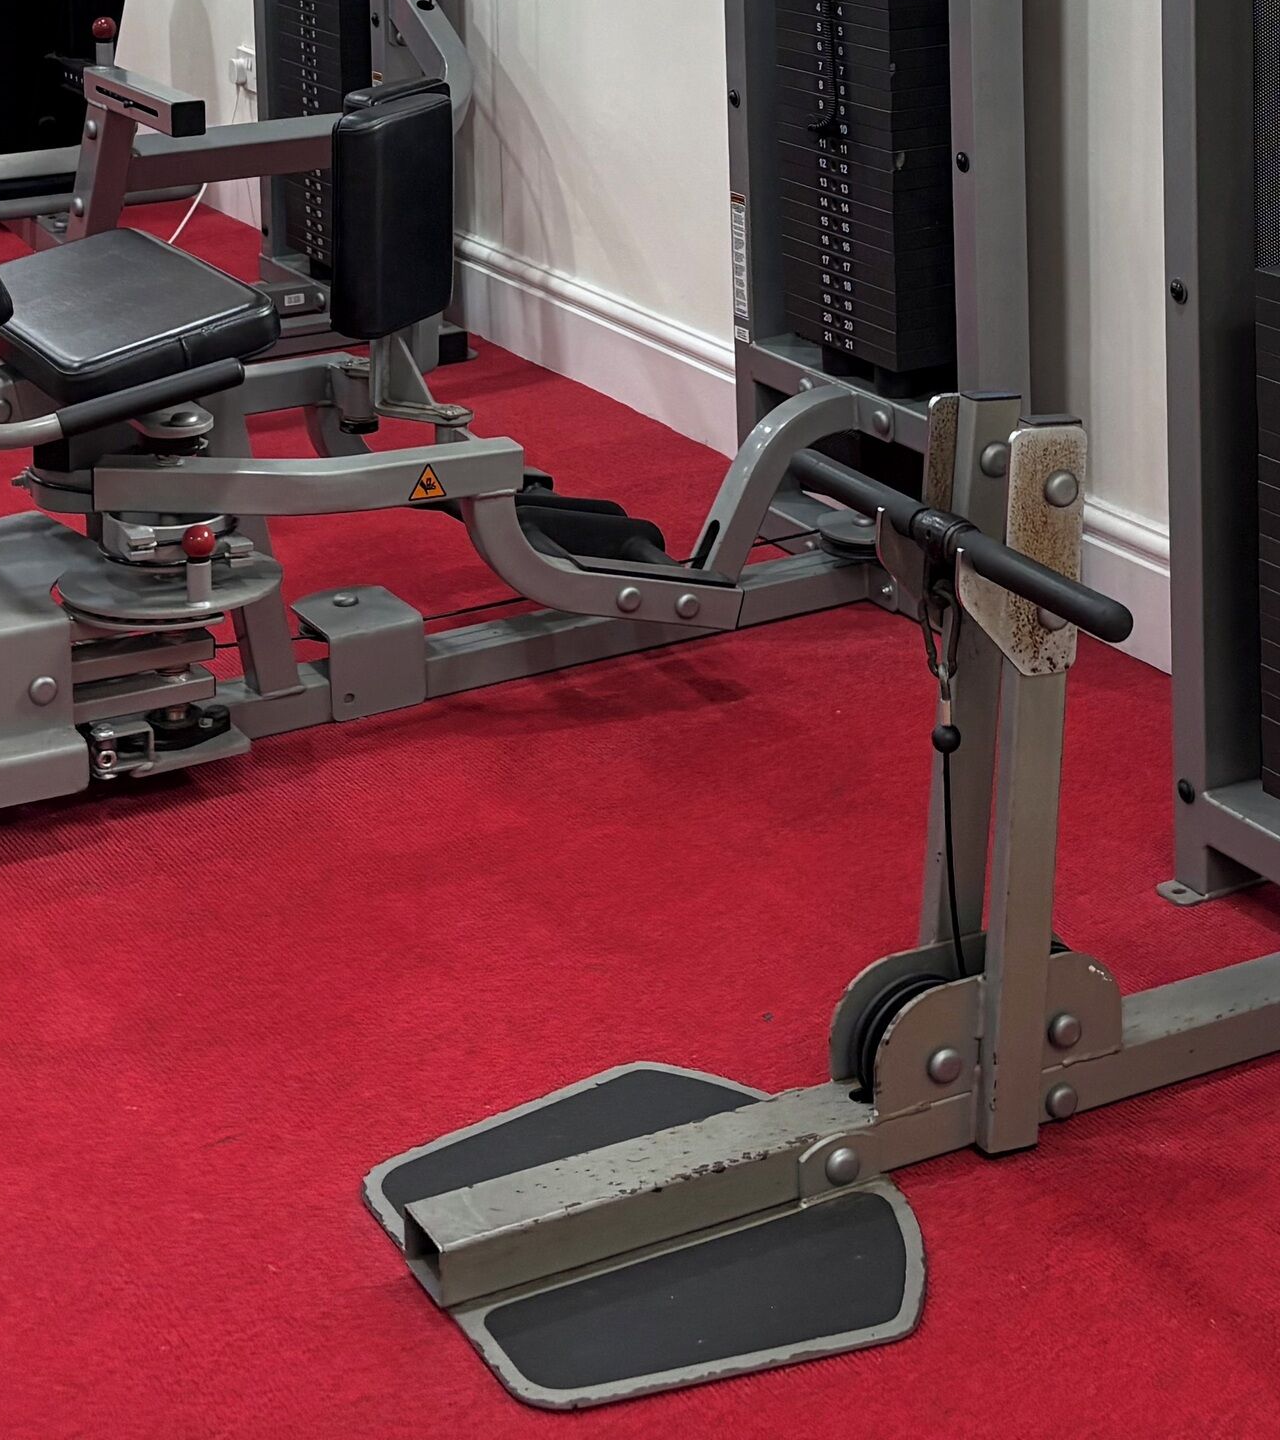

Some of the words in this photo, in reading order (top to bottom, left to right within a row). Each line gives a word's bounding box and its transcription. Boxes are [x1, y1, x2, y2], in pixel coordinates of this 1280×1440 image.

[815, 2, 821, 12] 4
[837, 6, 843, 16] 4
[816, 22, 822, 32] 5
[838, 26, 843, 36] 5
[817, 61, 823, 71] 7
[839, 65, 844, 76] 7
[818, 138, 826, 149] 11
[840, 144, 848, 155] 11
[818, 158, 827, 169] 12
[839, 163, 848, 174] 12
[819, 177, 828, 188] 13
[840, 183, 849, 194] 13
[819, 197, 828, 207] 14
[840, 202, 849, 213] 14
[820, 216, 829, 227] 15
[841, 222, 850, 233] 15
[821, 254, 830, 265] 17
[842, 262, 851, 272] 17
[823, 311, 833, 323] 20
[843, 319, 854, 331] 20
[824, 331, 833, 342] 21
[844, 338, 853, 350] 21
